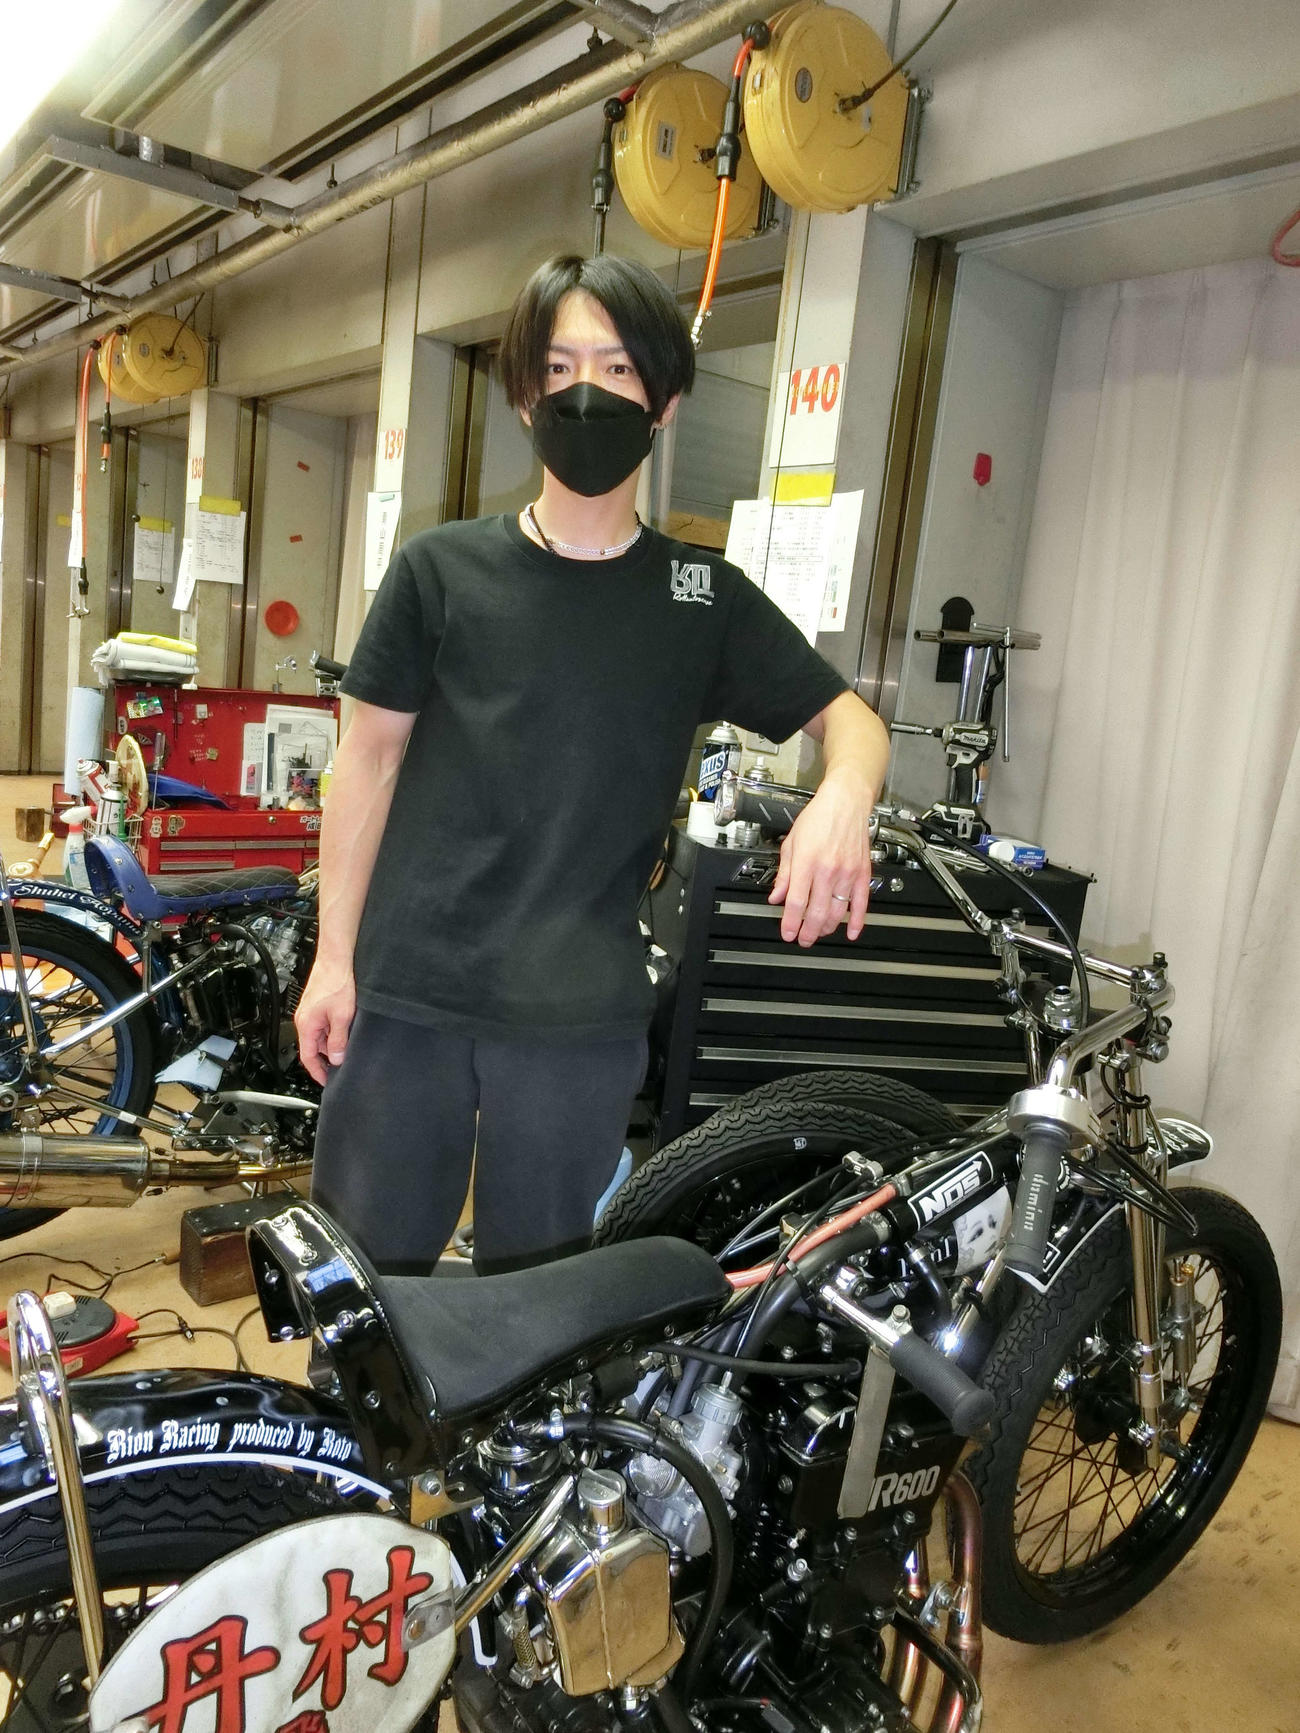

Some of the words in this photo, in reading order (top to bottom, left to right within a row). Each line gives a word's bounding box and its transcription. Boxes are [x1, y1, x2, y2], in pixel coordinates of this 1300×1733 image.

[790, 364, 840, 415] 140
[384, 429, 404, 459] 139
[14, 884, 78, 900] Shuhei
[918, 1164, 981, 1222] NOS
[106, 1426, 154, 1464] Rion
[160, 1417, 221, 1454] Racing
[226, 1417, 295, 1453] produced
[297, 1423, 316, 1457] by
[867, 1465, 941, 1512] R600
[125, 1545, 434, 1733] 丹村
